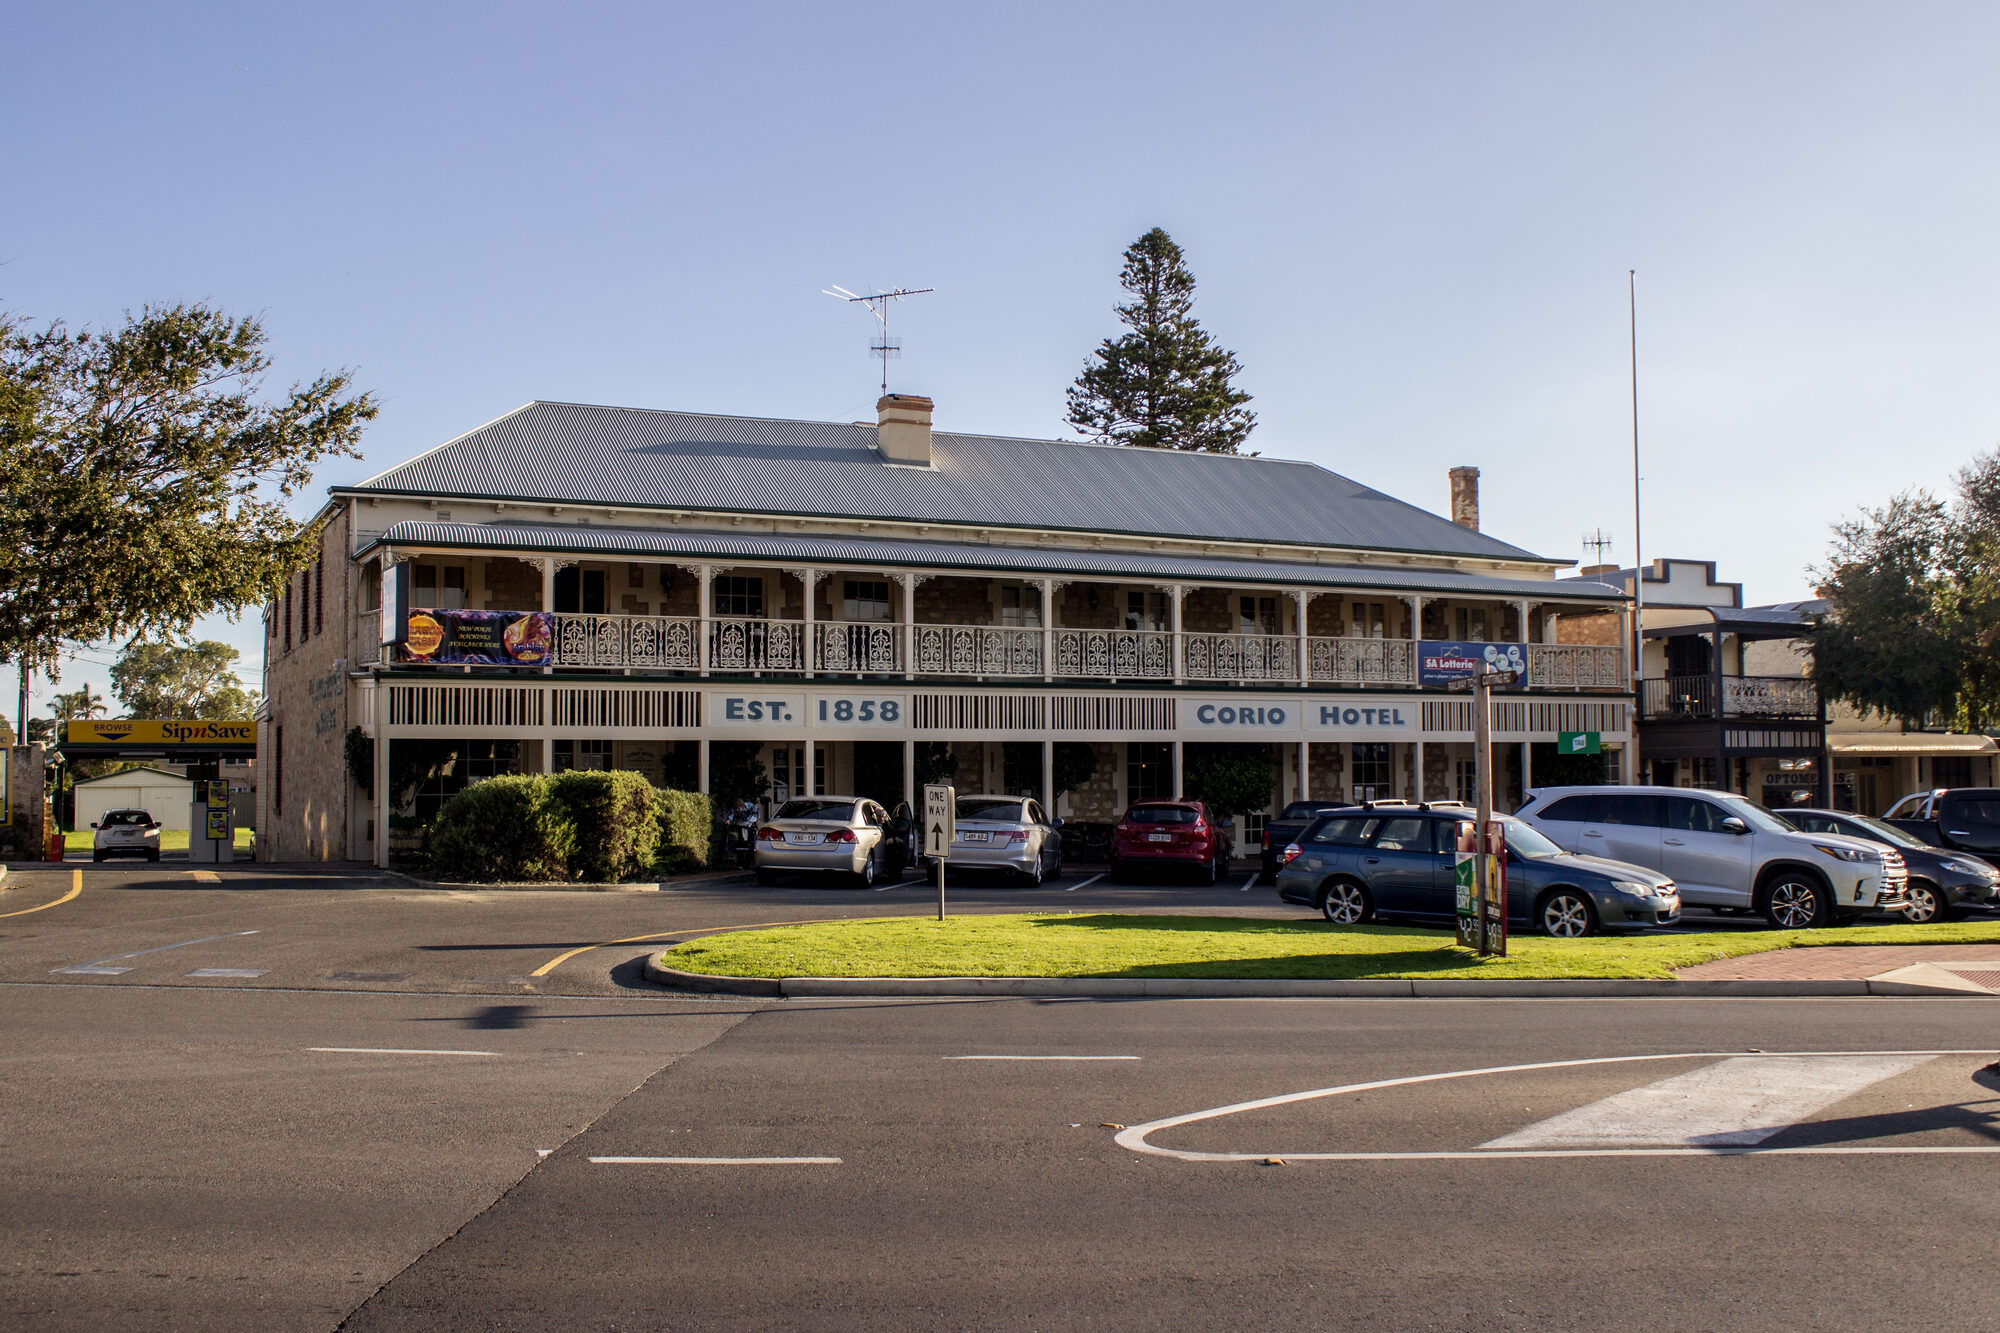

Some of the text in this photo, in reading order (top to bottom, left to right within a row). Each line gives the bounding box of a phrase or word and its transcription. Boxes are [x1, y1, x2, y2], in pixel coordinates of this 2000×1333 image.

[1425, 657, 1473, 670] SA Lotterie
[726, 698, 900, 721] EST. 1858
[1197, 704, 1405, 725] CORIO HOTEL
[94, 723, 133, 731] BROWSE
[162, 722, 250, 742] SipnSave
[928, 791, 945, 802] ONE
[928, 804, 946, 817] WAY
[1457, 894, 1470, 909] DRY
